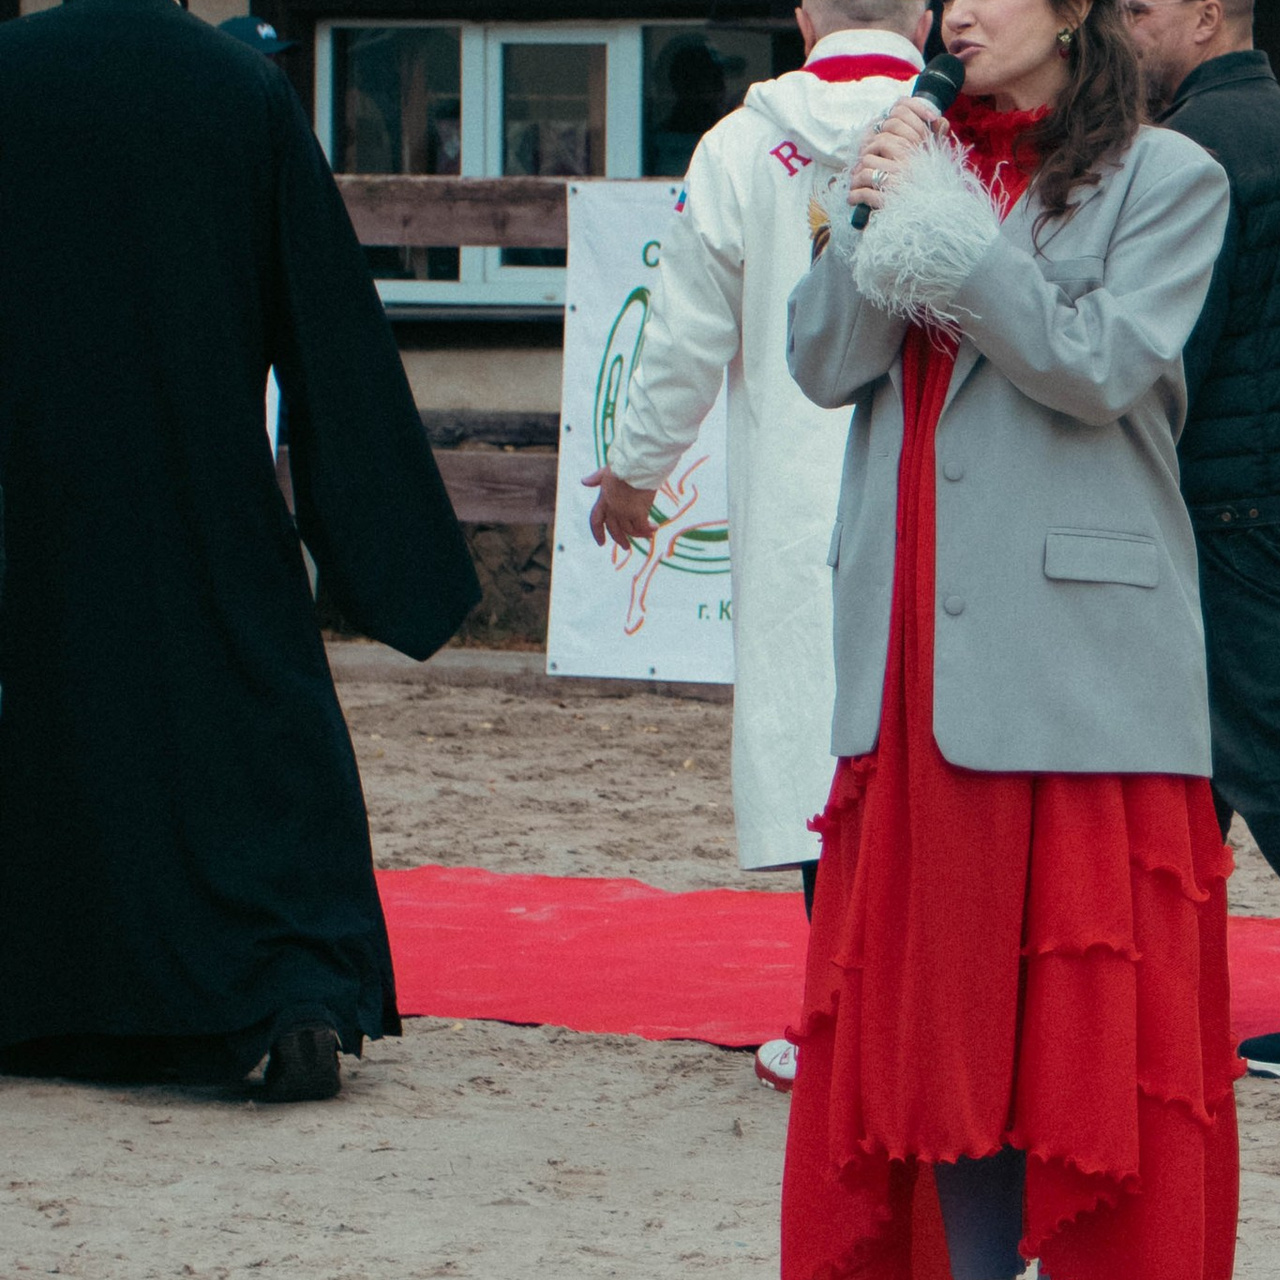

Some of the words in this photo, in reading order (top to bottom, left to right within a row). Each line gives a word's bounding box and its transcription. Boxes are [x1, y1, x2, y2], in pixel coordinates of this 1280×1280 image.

[769, 140, 813, 177] R
[642, 240, 661, 268] С
[719, 600, 732, 620] К
